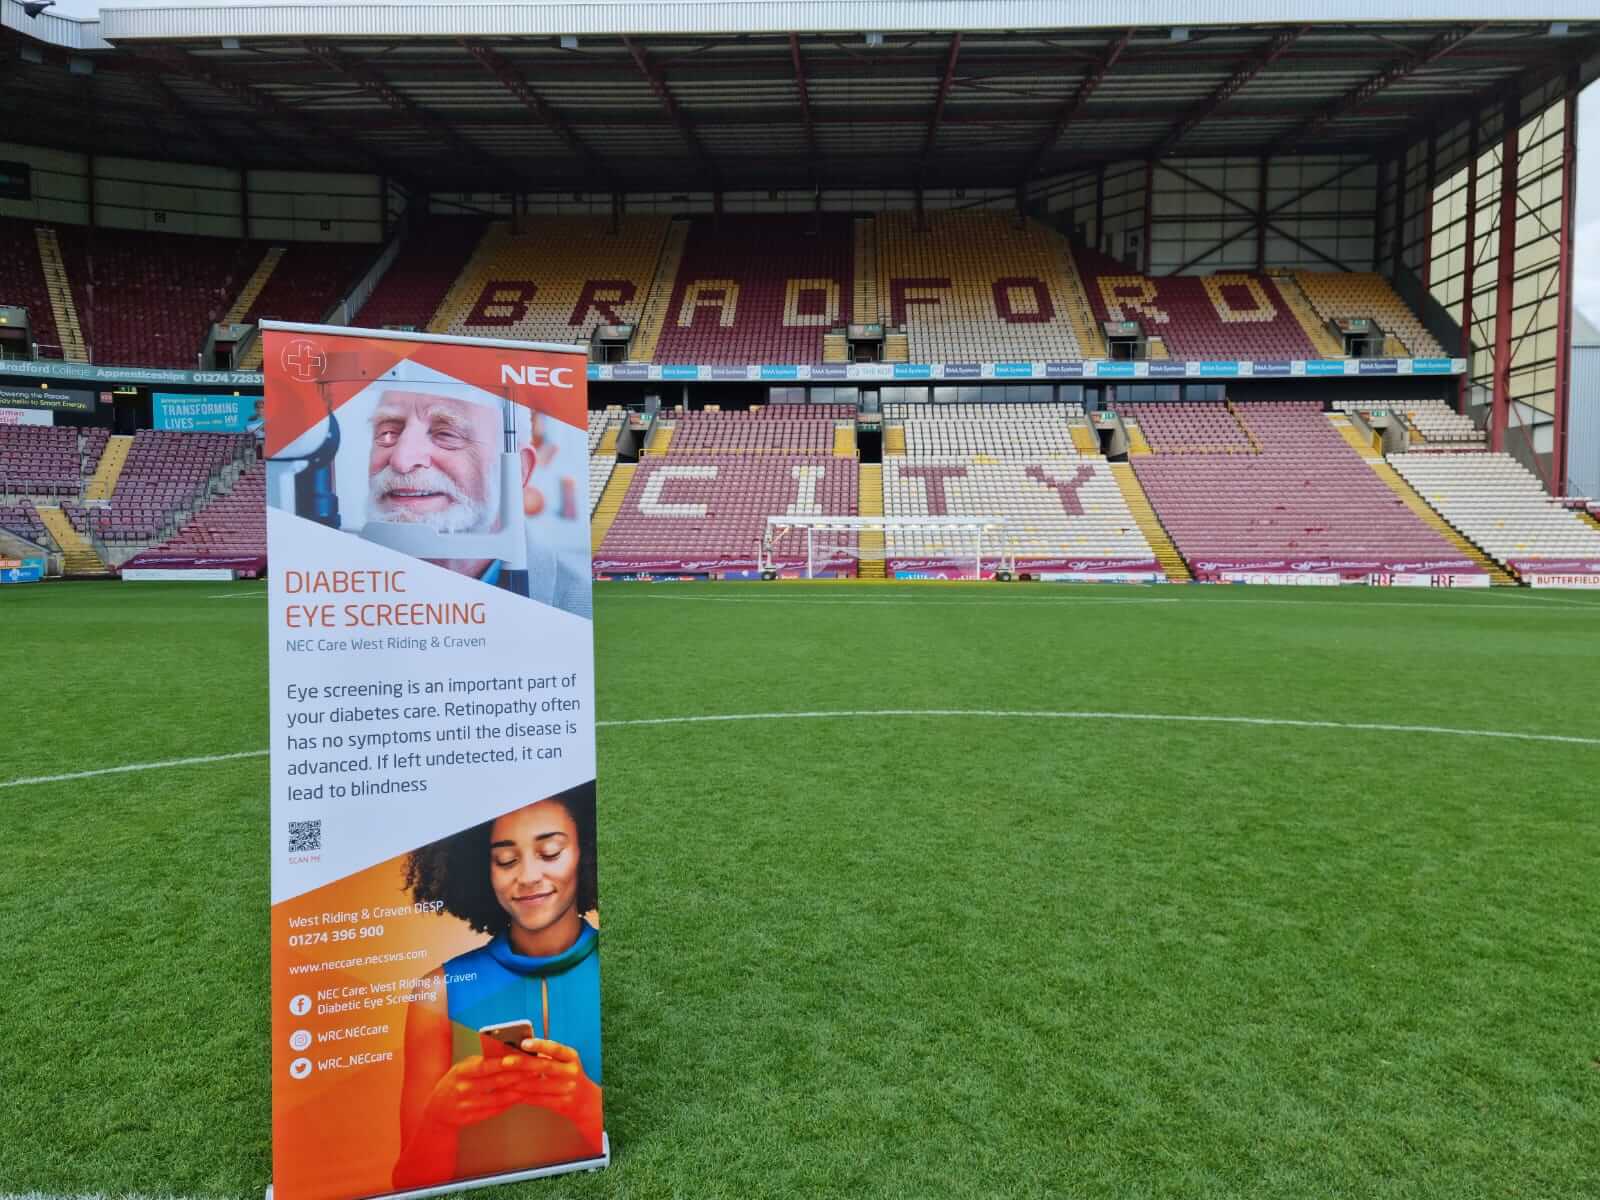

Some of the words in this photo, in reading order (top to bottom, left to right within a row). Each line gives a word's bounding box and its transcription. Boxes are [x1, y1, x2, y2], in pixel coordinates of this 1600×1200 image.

[463, 278, 1277, 326] BRADFORD
[97, 368, 186, 382] Apprenticeships
[193, 373, 228, 383] 01274
[501, 364, 573, 389] NEC
[162, 403, 239, 415] TRANSFORMING
[165, 418, 194, 429] LIVES
[637, 464, 1096, 517] CITY
[285, 570, 406, 593] DIABETIC
[1431, 575, 1455, 588] HRF
[286, 604, 336, 627] EYE
[344, 603, 486, 626] SCREENING
[286, 639, 315, 652] NEC
[318, 639, 347, 651] Care
[351, 638, 384, 650] West
[387, 637, 427, 651] Riding
[430, 637, 440, 648] &
[443, 636, 486, 648] Craven
[287, 684, 318, 702] Eye
[323, 680, 403, 699] screening
[408, 680, 420, 694] is
[425, 681, 443, 694] an
[449, 677, 523, 694] important
[527, 676, 557, 692] part
[561, 673, 577, 688] of
[287, 711, 324, 728] your
[330, 705, 399, 723] diabetes
[403, 705, 440, 718] care.
[445, 699, 536, 718] Retinopathy
[541, 698, 581, 712] often
[288, 736, 317, 750] has
[322, 735, 343, 748] no
[348, 729, 431, 748] symptoms
[436, 726, 470, 742] until
[476, 725, 501, 739] the
[505, 722, 561, 737] disease
[565, 721, 577, 734] is
[287, 758, 372, 776] advanced.
[377, 755, 388, 770] If
[393, 754, 421, 769] left
[426, 746, 517, 766] undetected,
[522, 746, 533, 760] it
[536, 747, 562, 760] can
[288, 784, 323, 801] lead
[328, 784, 346, 798] to
[351, 778, 427, 797] blindness
[288, 856, 308, 864] SCAN
[289, 916, 319, 929] West
[322, 911, 358, 924] Riding
[361, 909, 369, 920] &
[373, 904, 411, 918] Craven
[415, 900, 444, 913] DESP
[289, 932, 328, 946] 01274
[332, 928, 356, 941] 396
[359, 925, 384, 938] 900
[289, 949, 427, 975] www.neccare.necsws.com
[317, 988, 339, 1001] NEC
[342, 986, 368, 998] Care:
[370, 982, 396, 994] West
[399, 977, 431, 991] Riding
[433, 975, 441, 985] &
[443, 971, 477, 984] Craven
[317, 1002, 360, 1016] Diabetic
[363, 999, 384, 1010] Eye
[387, 991, 437, 1006] Screening
[317, 1050, 393, 1071] WRC_NECcare
